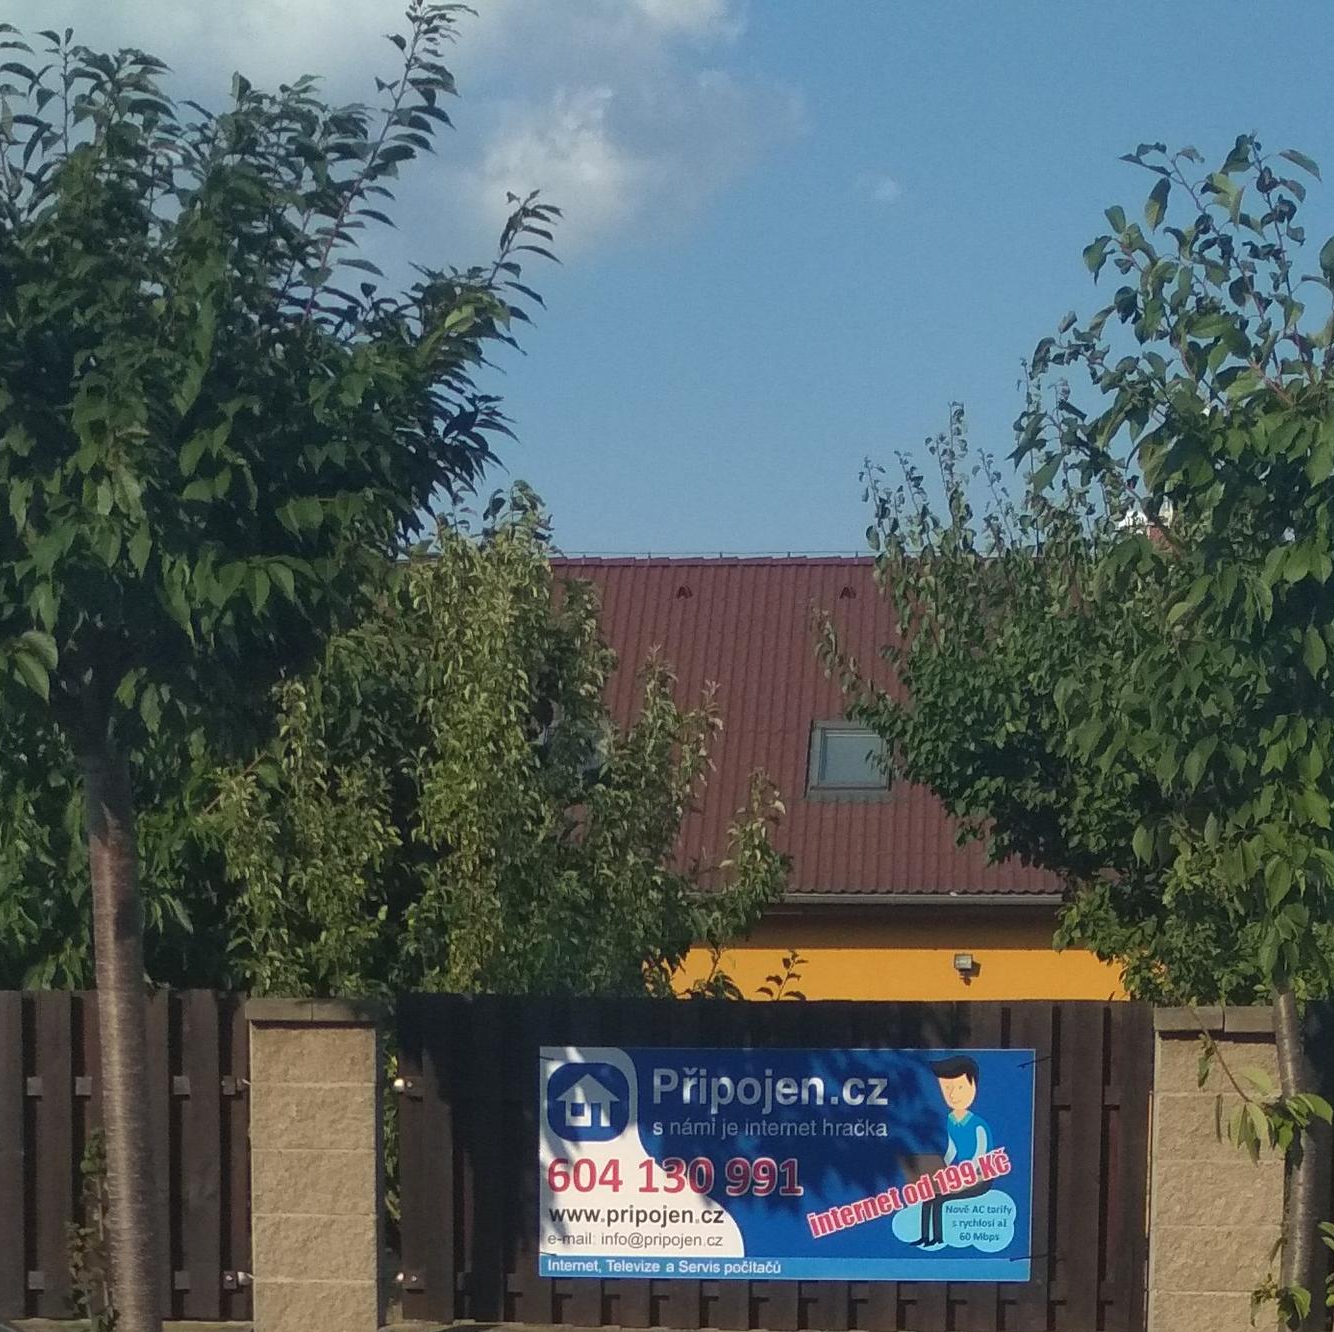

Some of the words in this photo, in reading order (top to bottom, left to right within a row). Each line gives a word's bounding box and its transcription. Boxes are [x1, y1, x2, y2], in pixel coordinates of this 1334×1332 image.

[653, 1066, 889, 1115] Připojen.cz
[652, 1119, 664, 1136] s
[670, 1116, 715, 1136] námi
[721, 1117, 738, 1140] je
[745, 1118, 817, 1137] internet
[822, 1117, 889, 1137] hračka
[547, 1157, 624, 1194] 604
[638, 1157, 715, 1196] 130
[725, 1157, 805, 1197] 991
[806, 1186, 903, 1240] internet
[902, 1176, 937, 1205] od
[934, 1161, 978, 1196] 199
[978, 1147, 1012, 1182] Kč
[548, 1204, 725, 1228] www.pripojen.cz
[972, 1204, 985, 1214] AC
[987, 1204, 1013, 1216] tarify
[601, 1231, 724, 1249] info@pripojen.cz
[959, 1231, 971, 1241] 60
[973, 1231, 1000, 1243] Mbps
[547, 1258, 603, 1274] Internet,
[607, 1259, 660, 1273] Televize
[665, 1261, 675, 1273] a
[678, 1259, 721, 1274] Servis
